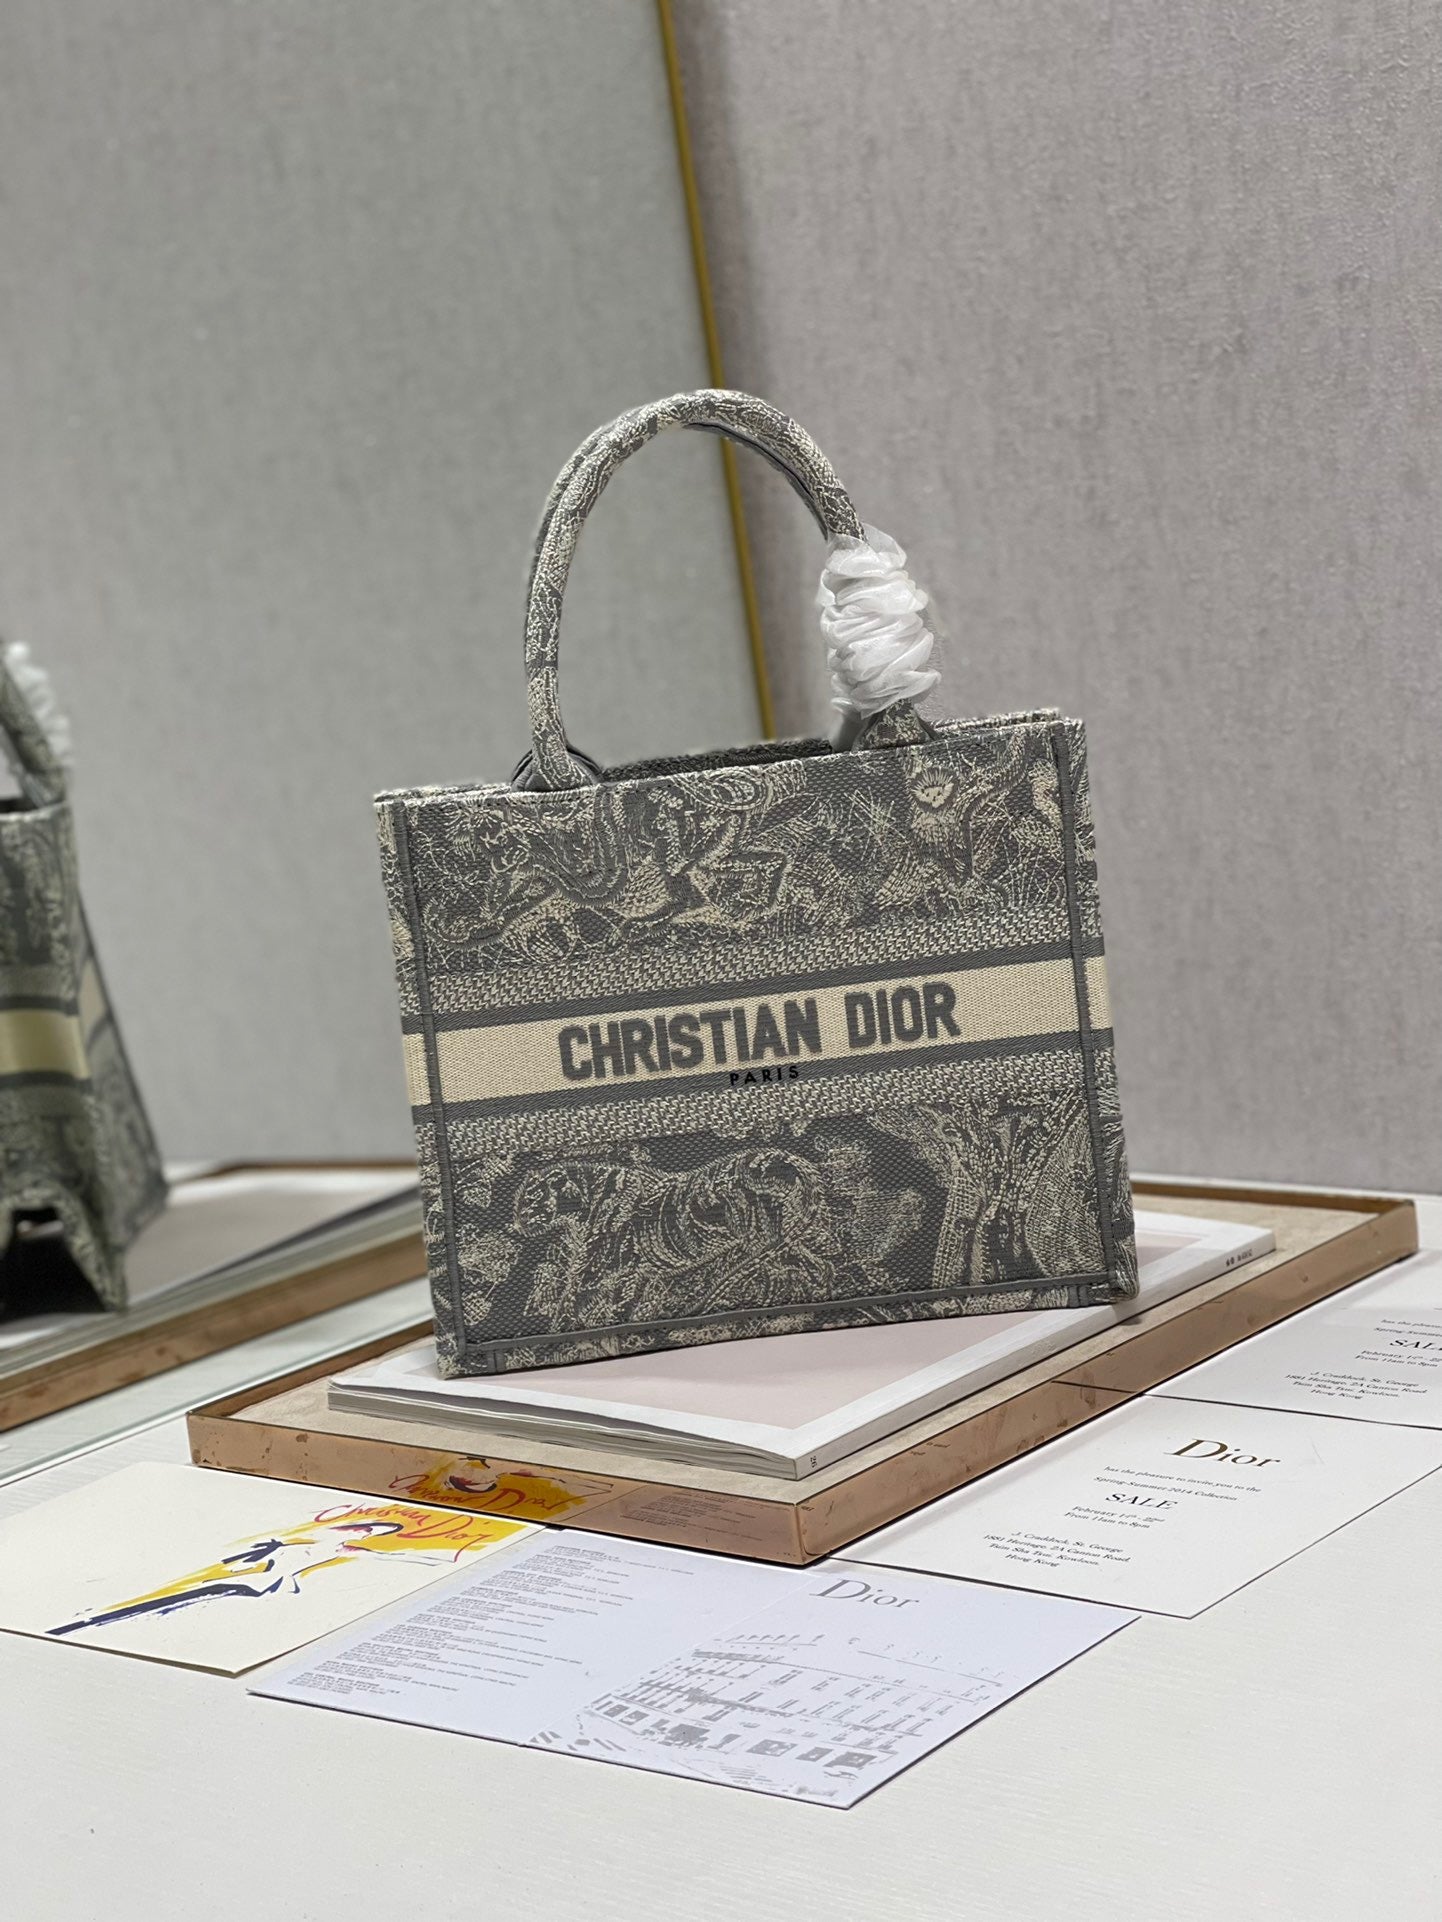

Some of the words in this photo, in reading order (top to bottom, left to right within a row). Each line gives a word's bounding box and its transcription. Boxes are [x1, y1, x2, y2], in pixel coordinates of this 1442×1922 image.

[558, 999, 822, 1081] CHRISTIAN
[844, 981, 962, 1049] DIOR
[730, 1065, 799, 1086] PARIS
[1389, 1339, 1442, 1351] SAL
[1163, 1439, 1281, 1468] Dior
[1105, 1492, 1178, 1510] SALE
[1064, 1511, 1089, 1520] From
[1072, 1505, 1117, 1518] February
[1067, 1548, 1101, 1558] Canton
[1089, 1543, 1124, 1553] George
[1005, 1553, 1032, 1563] Hong
[1034, 1558, 1060, 1567] Kong
[809, 1578, 920, 1608] Dior
